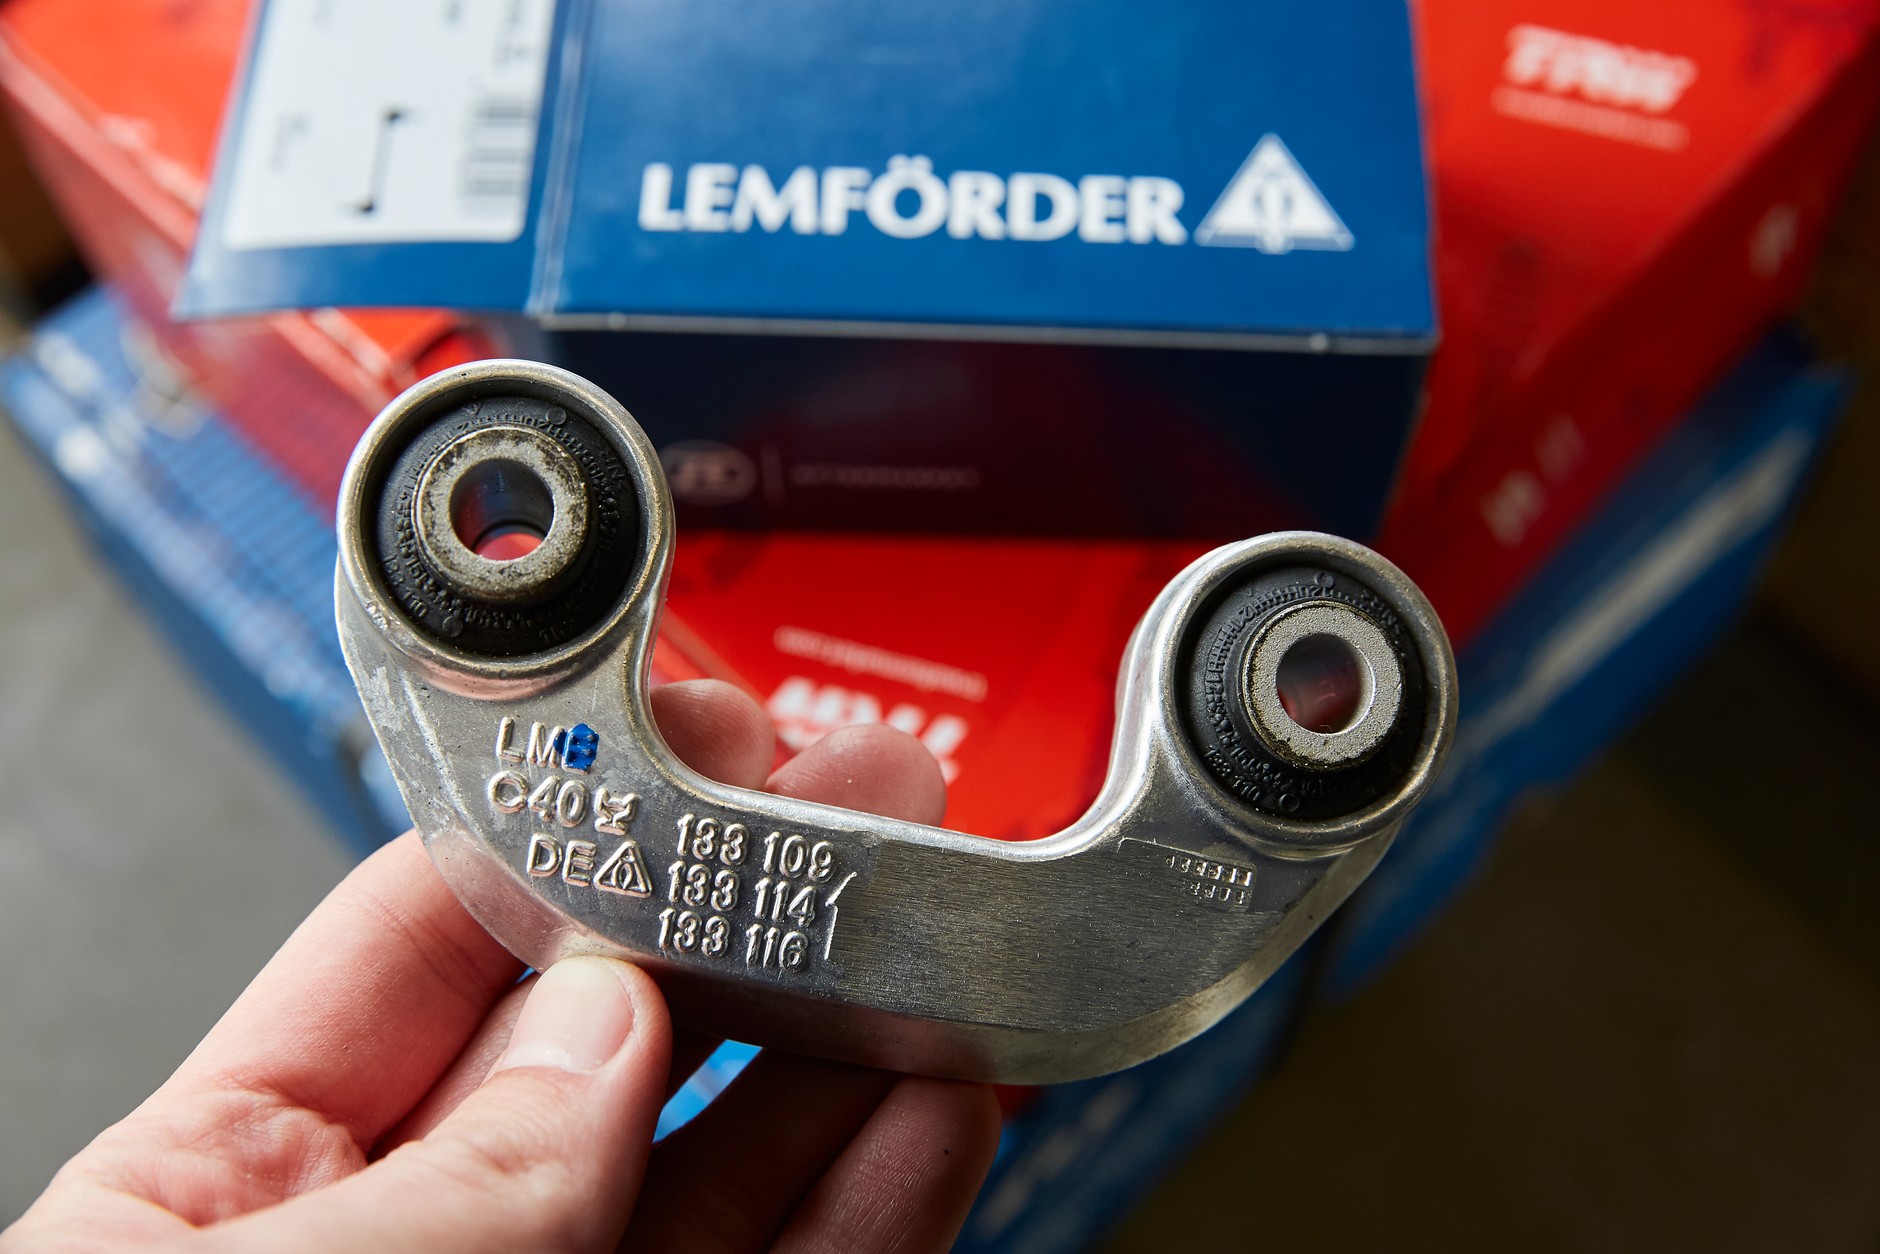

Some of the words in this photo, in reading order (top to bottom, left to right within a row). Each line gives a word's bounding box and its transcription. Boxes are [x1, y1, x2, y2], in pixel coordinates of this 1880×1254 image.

[638, 154, 1189, 246] LEMFÖRDER
[526, 832, 598, 887] DE
[677, 812, 749, 866] 133
[764, 831, 837, 882] 109
[667, 860, 741, 913] 133
[754, 877, 818, 927] 114
[658, 907, 732, 958] 133
[746, 922, 809, 973] 116
